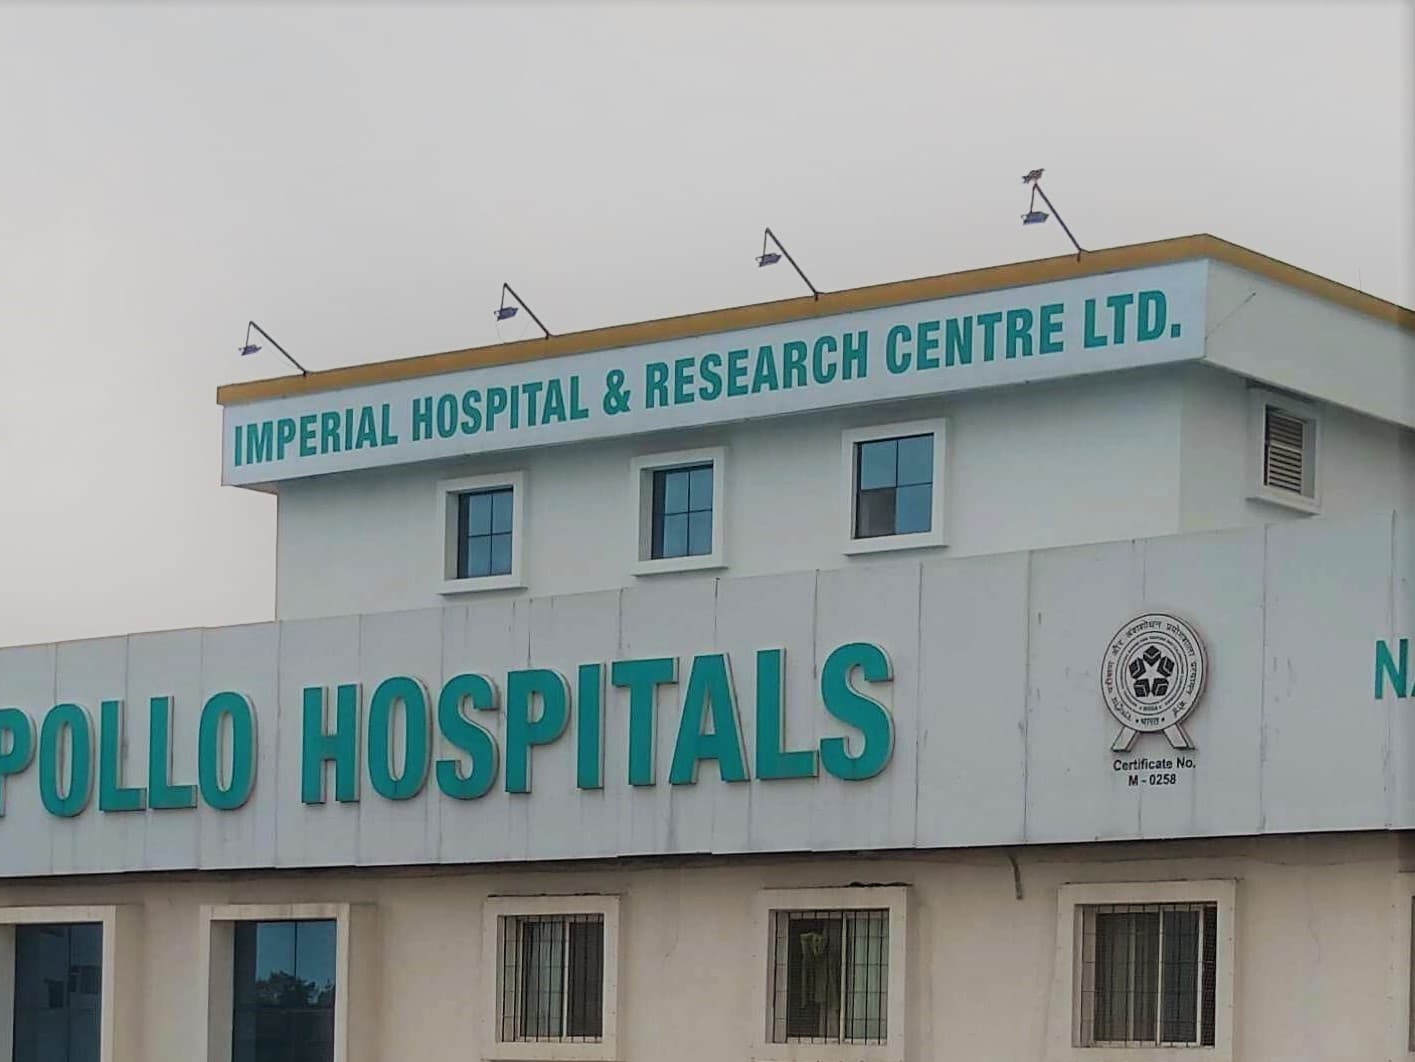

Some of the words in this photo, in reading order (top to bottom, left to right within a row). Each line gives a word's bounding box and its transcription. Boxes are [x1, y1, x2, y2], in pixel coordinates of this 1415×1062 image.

[233, 402, 399, 468] IMPERIAL
[410, 374, 590, 442] HOSPITAL
[600, 368, 632, 416] &
[643, 330, 869, 411] RESEARCH
[885, 301, 1065, 375] CENTRE
[1081, 288, 1182, 350] LTD.
[1374, 638, 1415, 700] N
[299, 641, 893, 805] HOSPITALS
[1113, 758, 1173, 771] Certificate
[1176, 756, 1196, 769] No.
[1128, 775, 1139, 787] M
[1149, 773, 1176, 785] 0258
